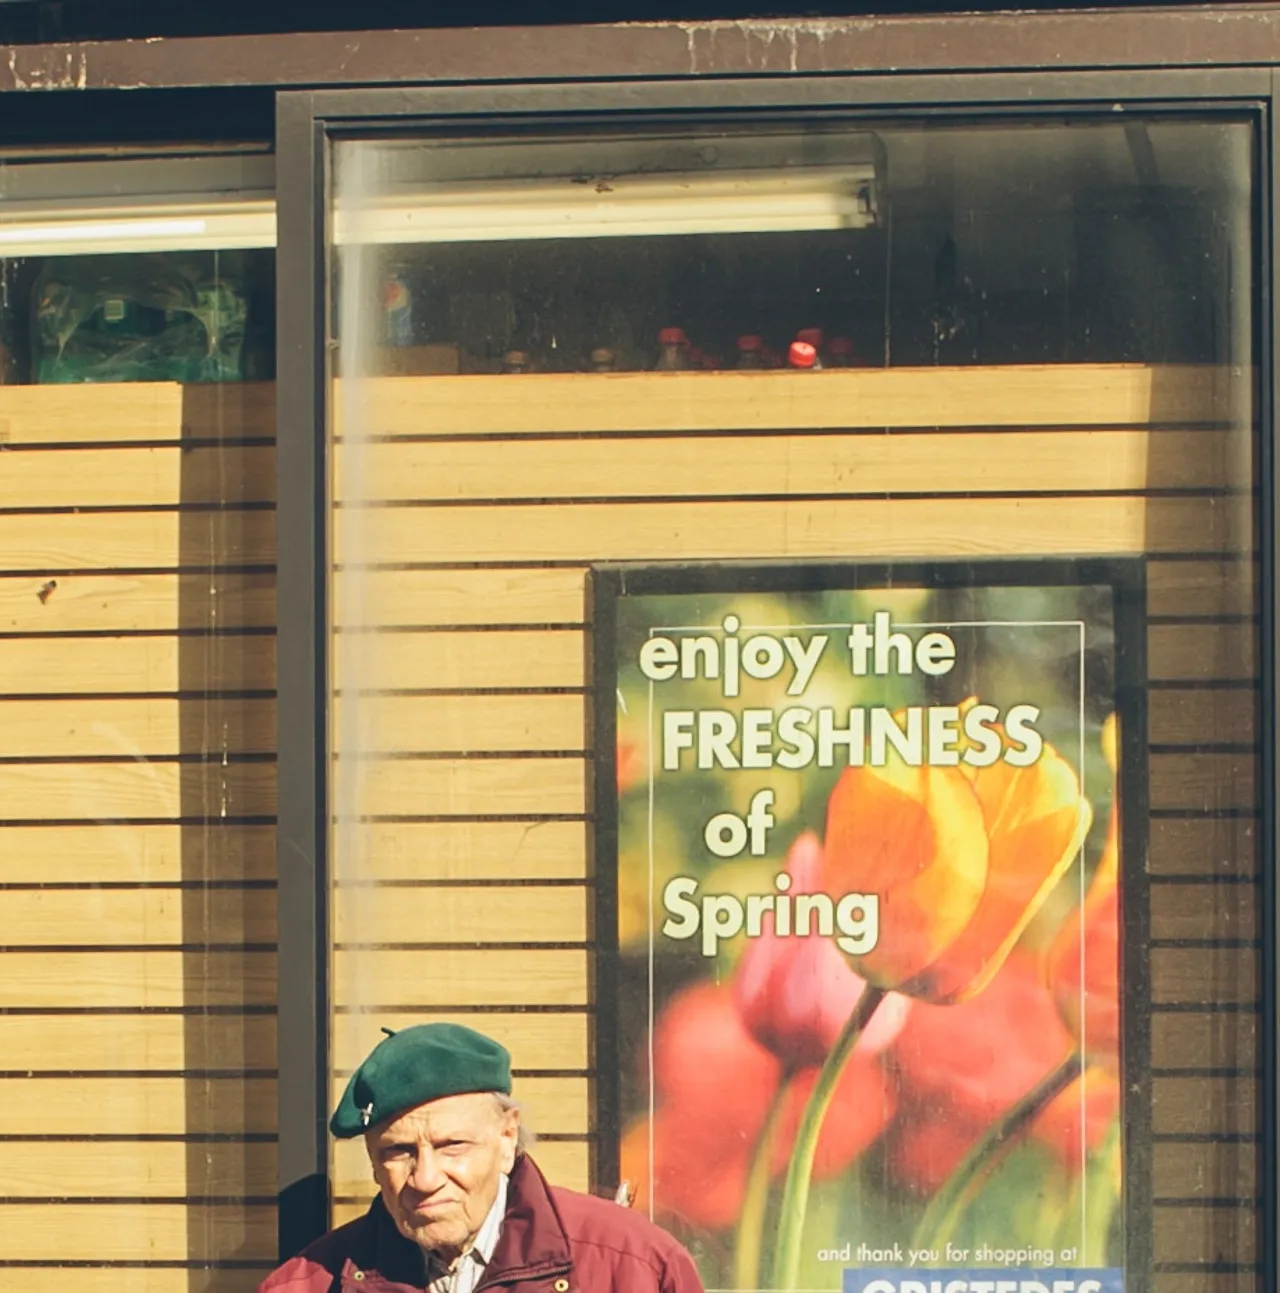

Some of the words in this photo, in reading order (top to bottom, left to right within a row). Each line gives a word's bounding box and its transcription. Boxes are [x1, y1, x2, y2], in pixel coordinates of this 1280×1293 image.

[639, 615, 828, 696] enjoy
[848, 612, 956, 675] the
[662, 704, 1044, 770] FRESHNESS
[704, 789, 775, 857] of
[662, 873, 879, 956] Spring
[817, 1244, 850, 1262] and
[856, 1243, 903, 1261] thank
[909, 1249, 939, 1266] you
[945, 1243, 969, 1261] for
[975, 1244, 1053, 1265] shopping
[1060, 1246, 1078, 1260] at
